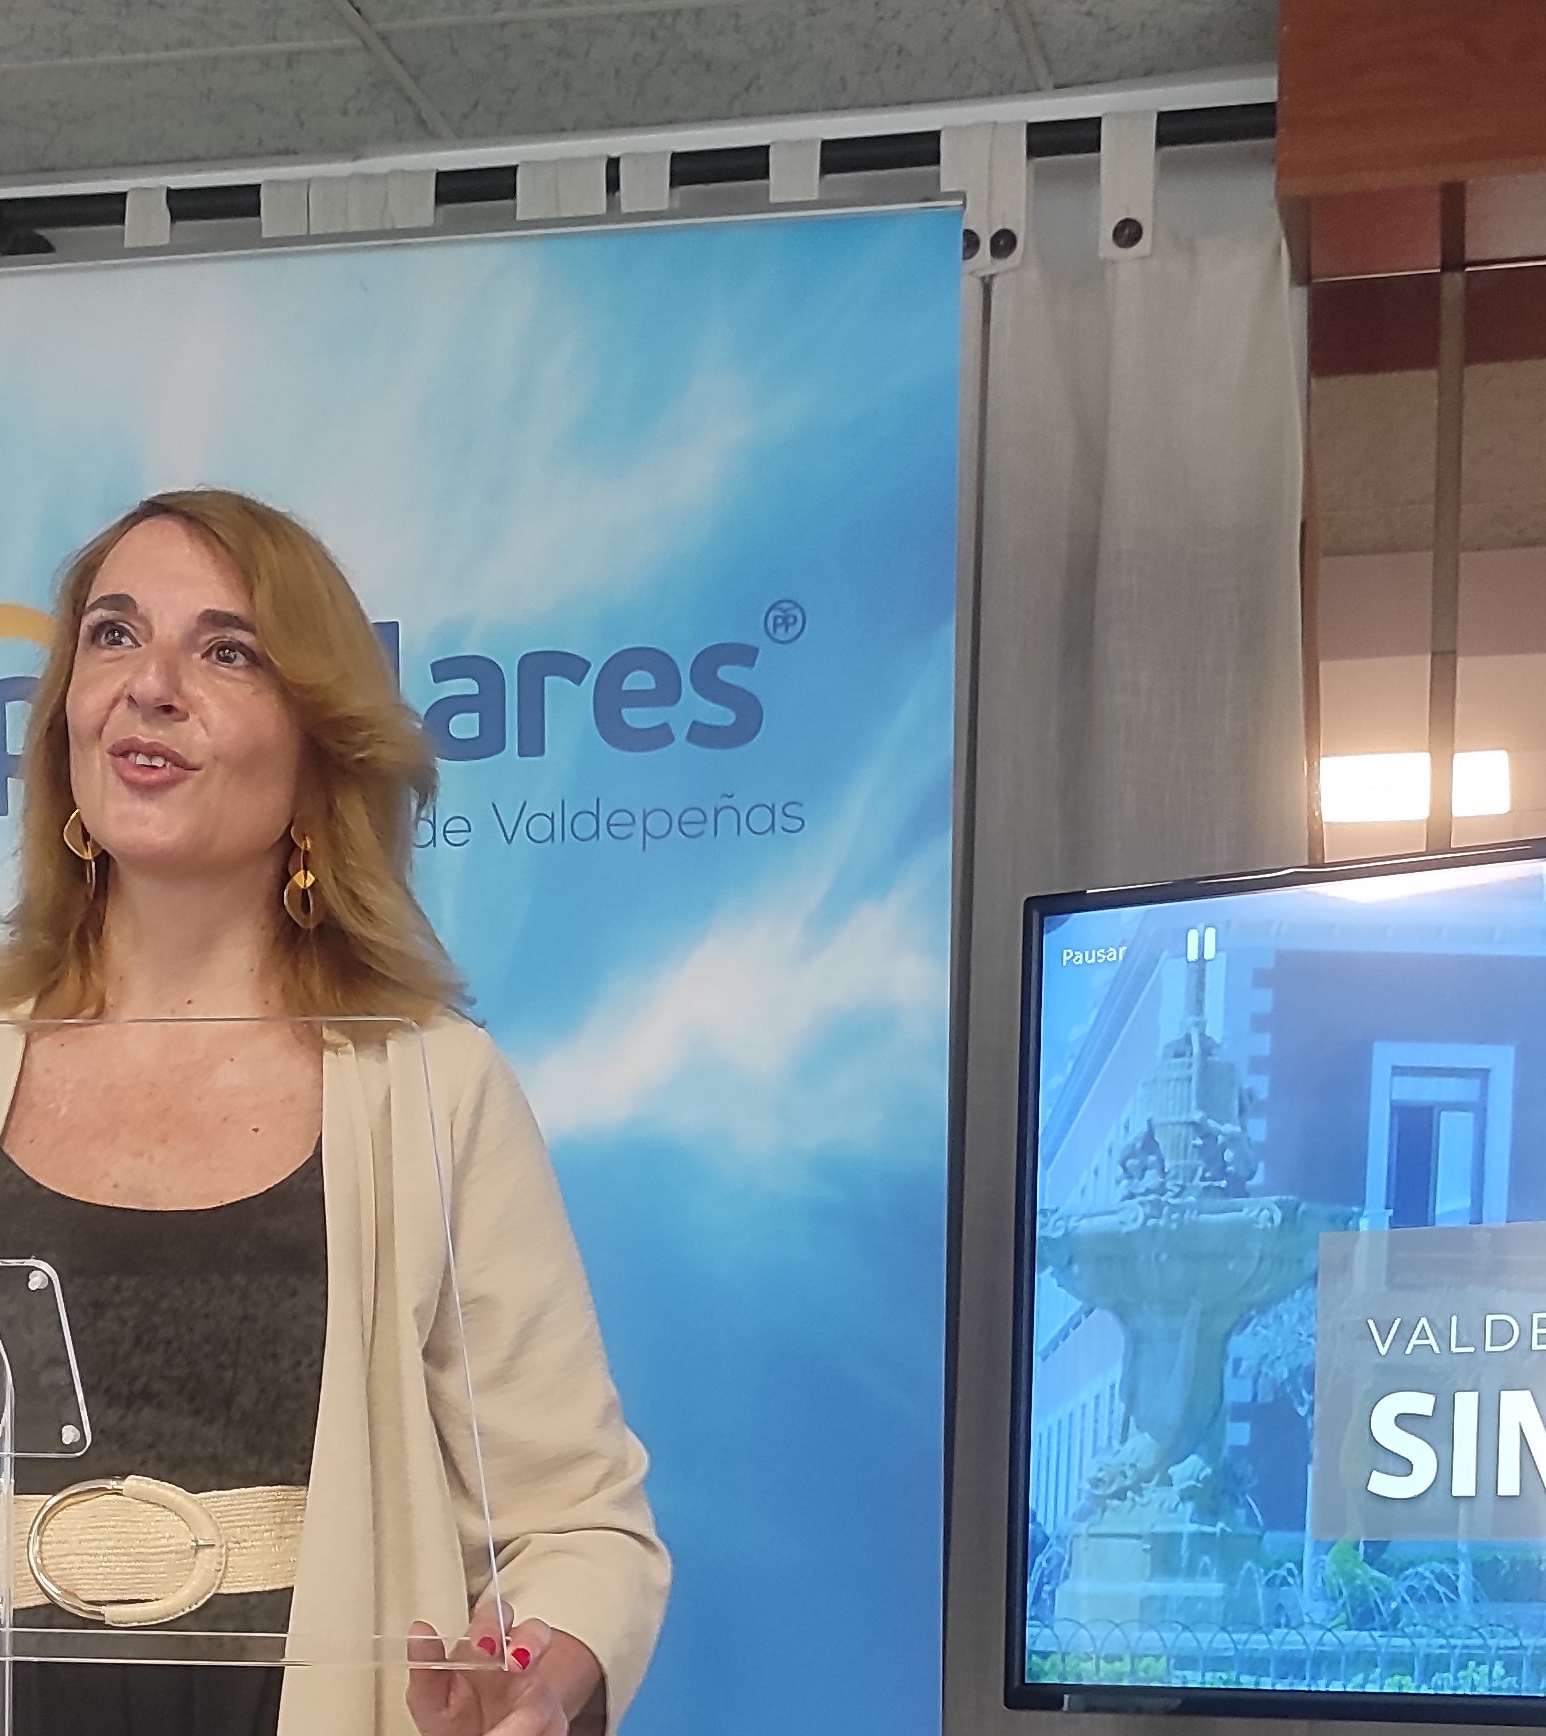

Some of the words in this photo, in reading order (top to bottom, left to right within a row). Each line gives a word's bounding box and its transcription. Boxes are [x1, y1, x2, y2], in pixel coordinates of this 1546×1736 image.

[414, 803, 472, 849] de
[491, 792, 806, 852] Valdepeñas
[1062, 946, 1129, 967] Pausar
